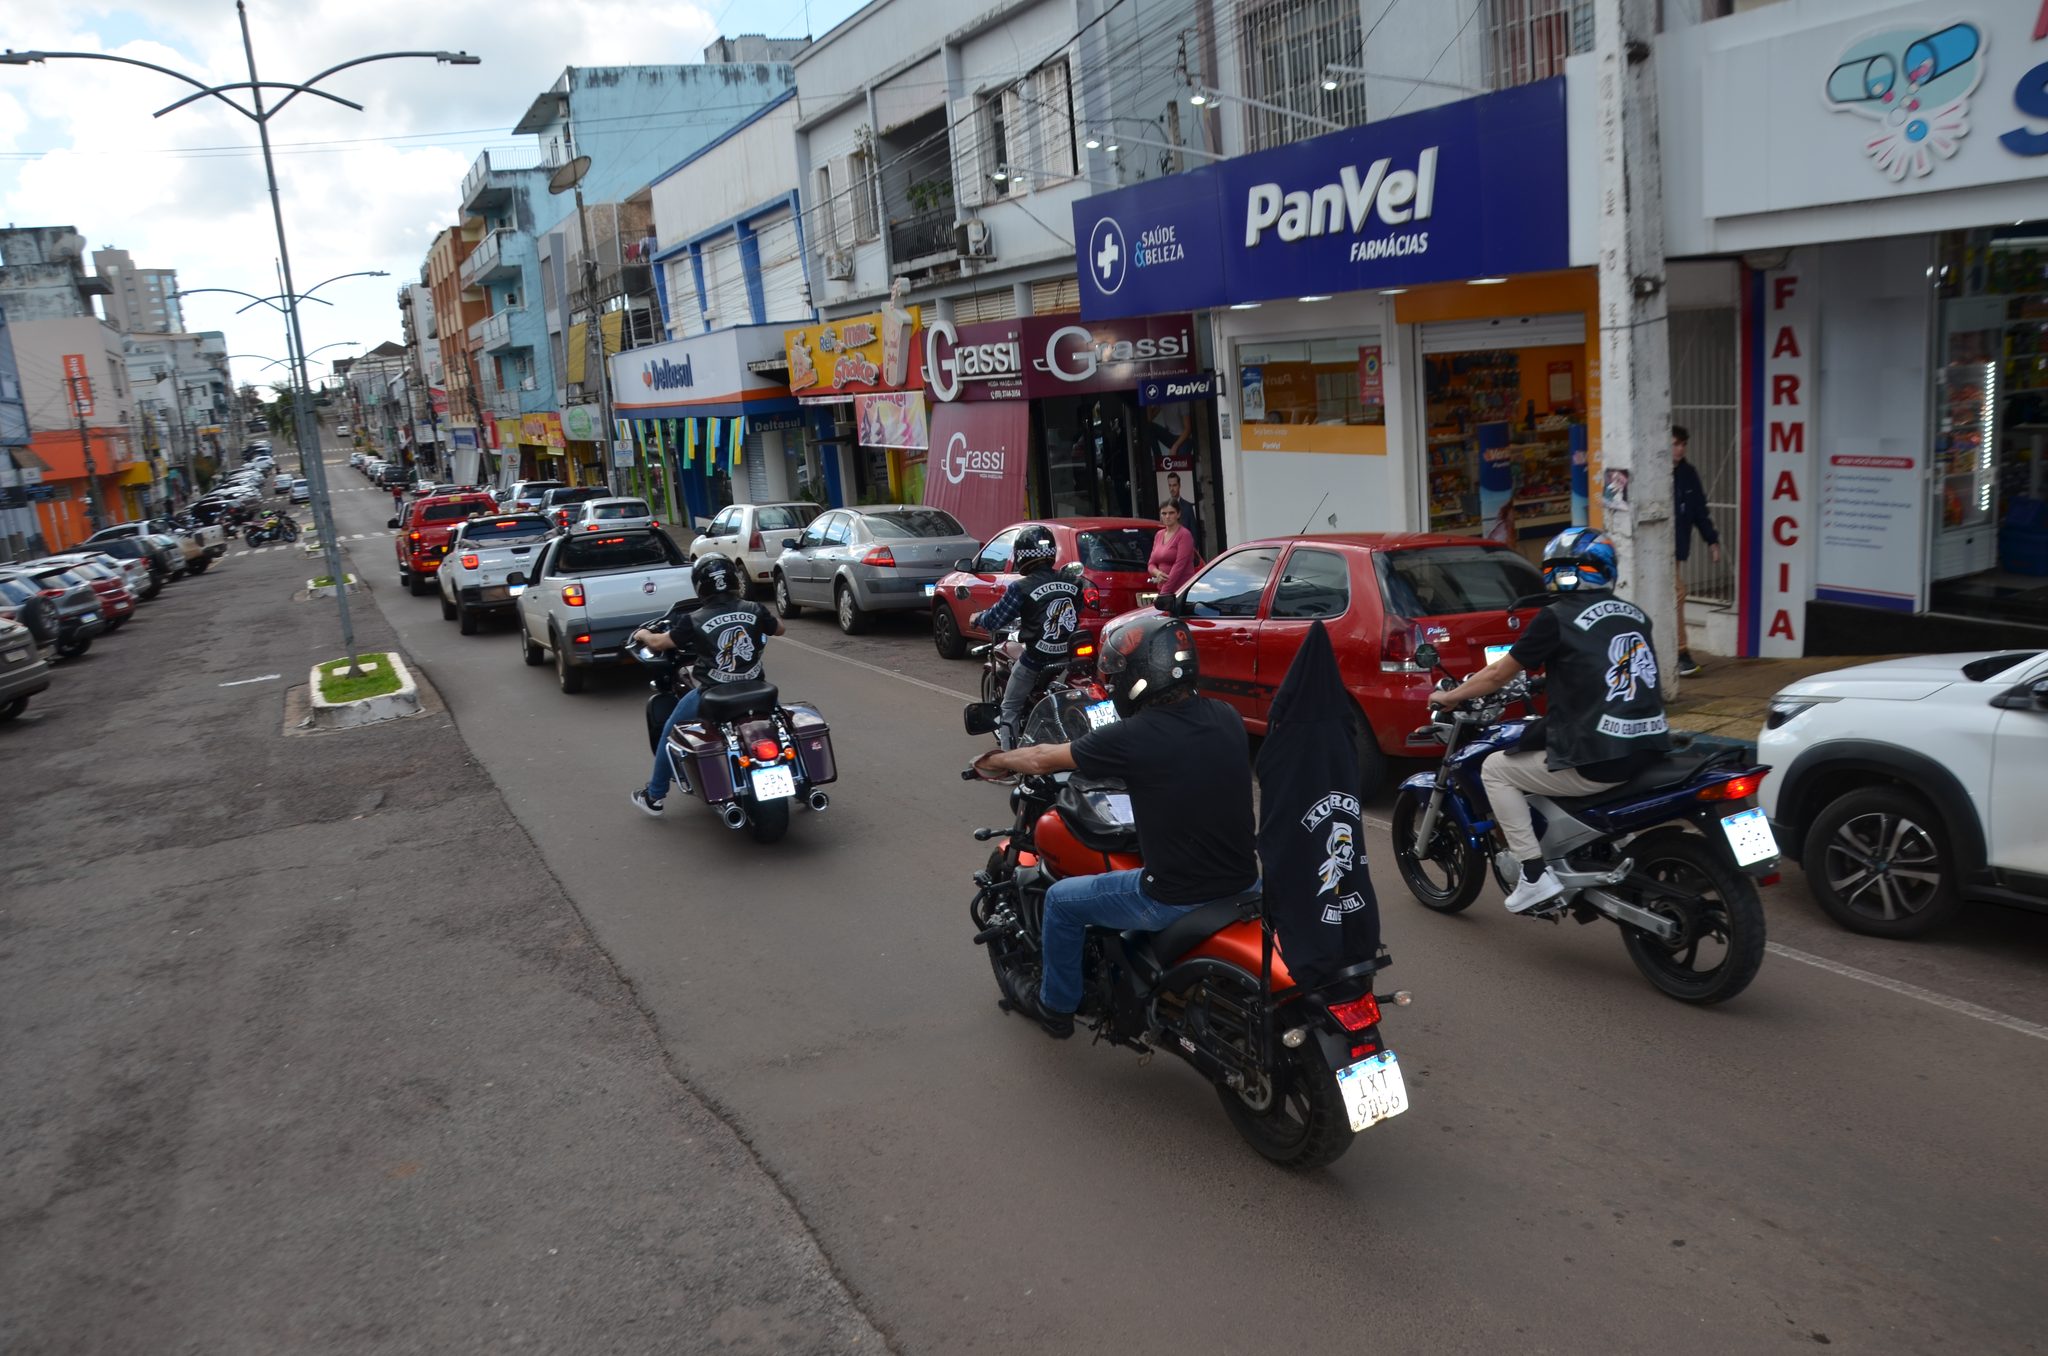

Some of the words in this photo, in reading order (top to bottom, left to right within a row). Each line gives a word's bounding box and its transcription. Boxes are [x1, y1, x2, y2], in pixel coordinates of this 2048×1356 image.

[1246, 146, 1439, 247] PanVel
[1142, 225, 1176, 248] SAÚDE
[1350, 232, 1429, 263] FARMÁCIAS
[1145, 243, 1185, 266] BELEZA
[921, 320, 1021, 401] Grassi
[1033, 326, 1189, 382] Grassi
[651, 353, 694, 391] Deltasul
[1166, 380, 1210, 397] PanVel
[755, 416, 800, 432] Deltasul
[942, 431, 1004, 484] Grassi
[1160, 456, 1188, 470] Grassi
[1768, 277, 1804, 641] FARMACIA
[1034, 583, 1077, 599] XUCROS
[705, 613, 754, 631] XUCROS
[1601, 719, 1620, 734] RIO
[1306, 794, 1360, 827] XUROS
[1343, 897, 1360, 910] SUL
[1358, 1069, 1388, 1099] IXT
